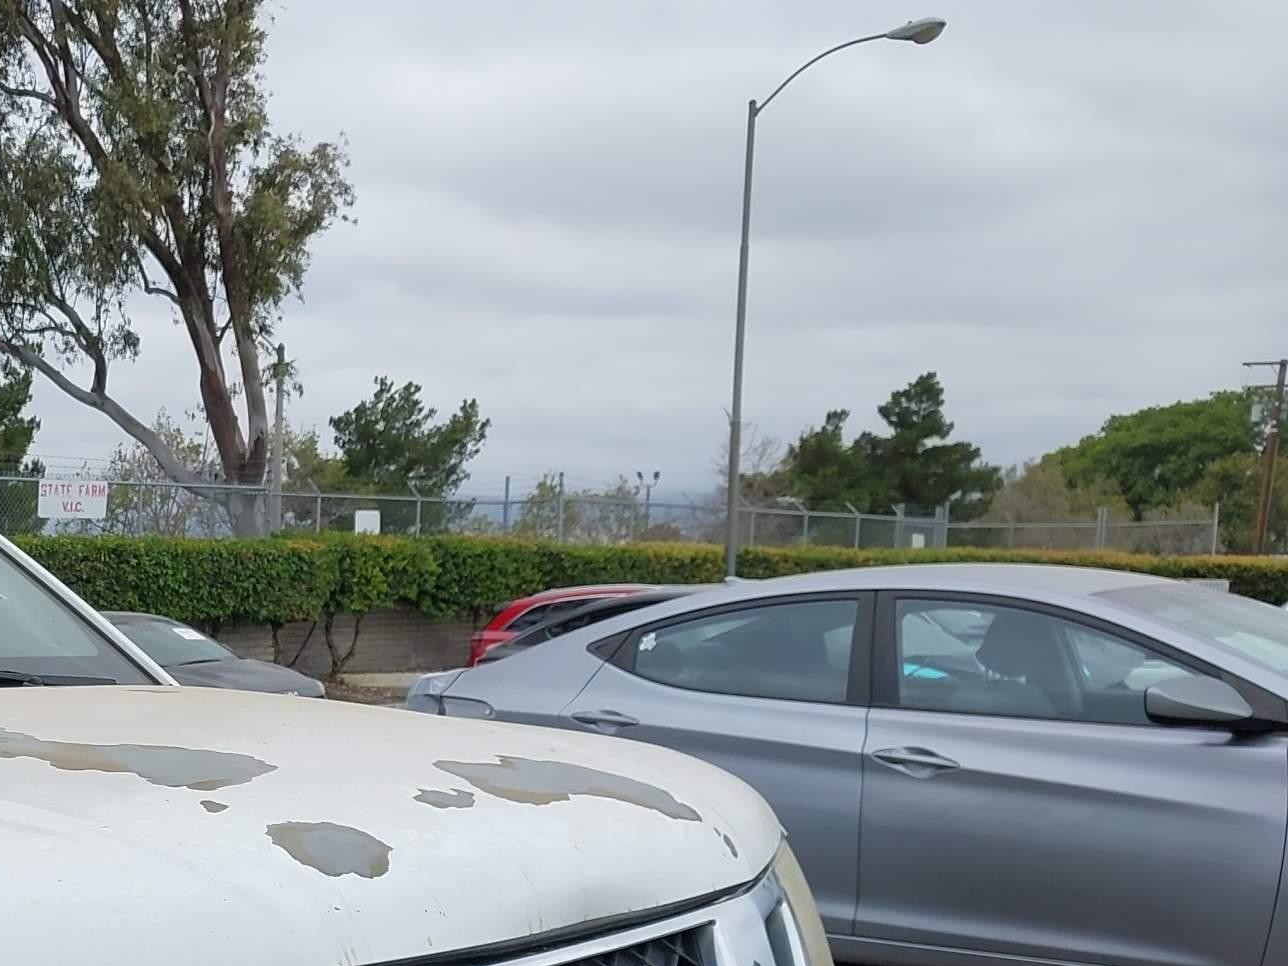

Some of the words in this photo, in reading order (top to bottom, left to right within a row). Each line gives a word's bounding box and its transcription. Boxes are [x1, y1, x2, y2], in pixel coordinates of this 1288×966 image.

[40, 483, 73, 498] STATE
[78, 483, 106, 498] FARM
[62, 501, 86, 513] V.I.C.
